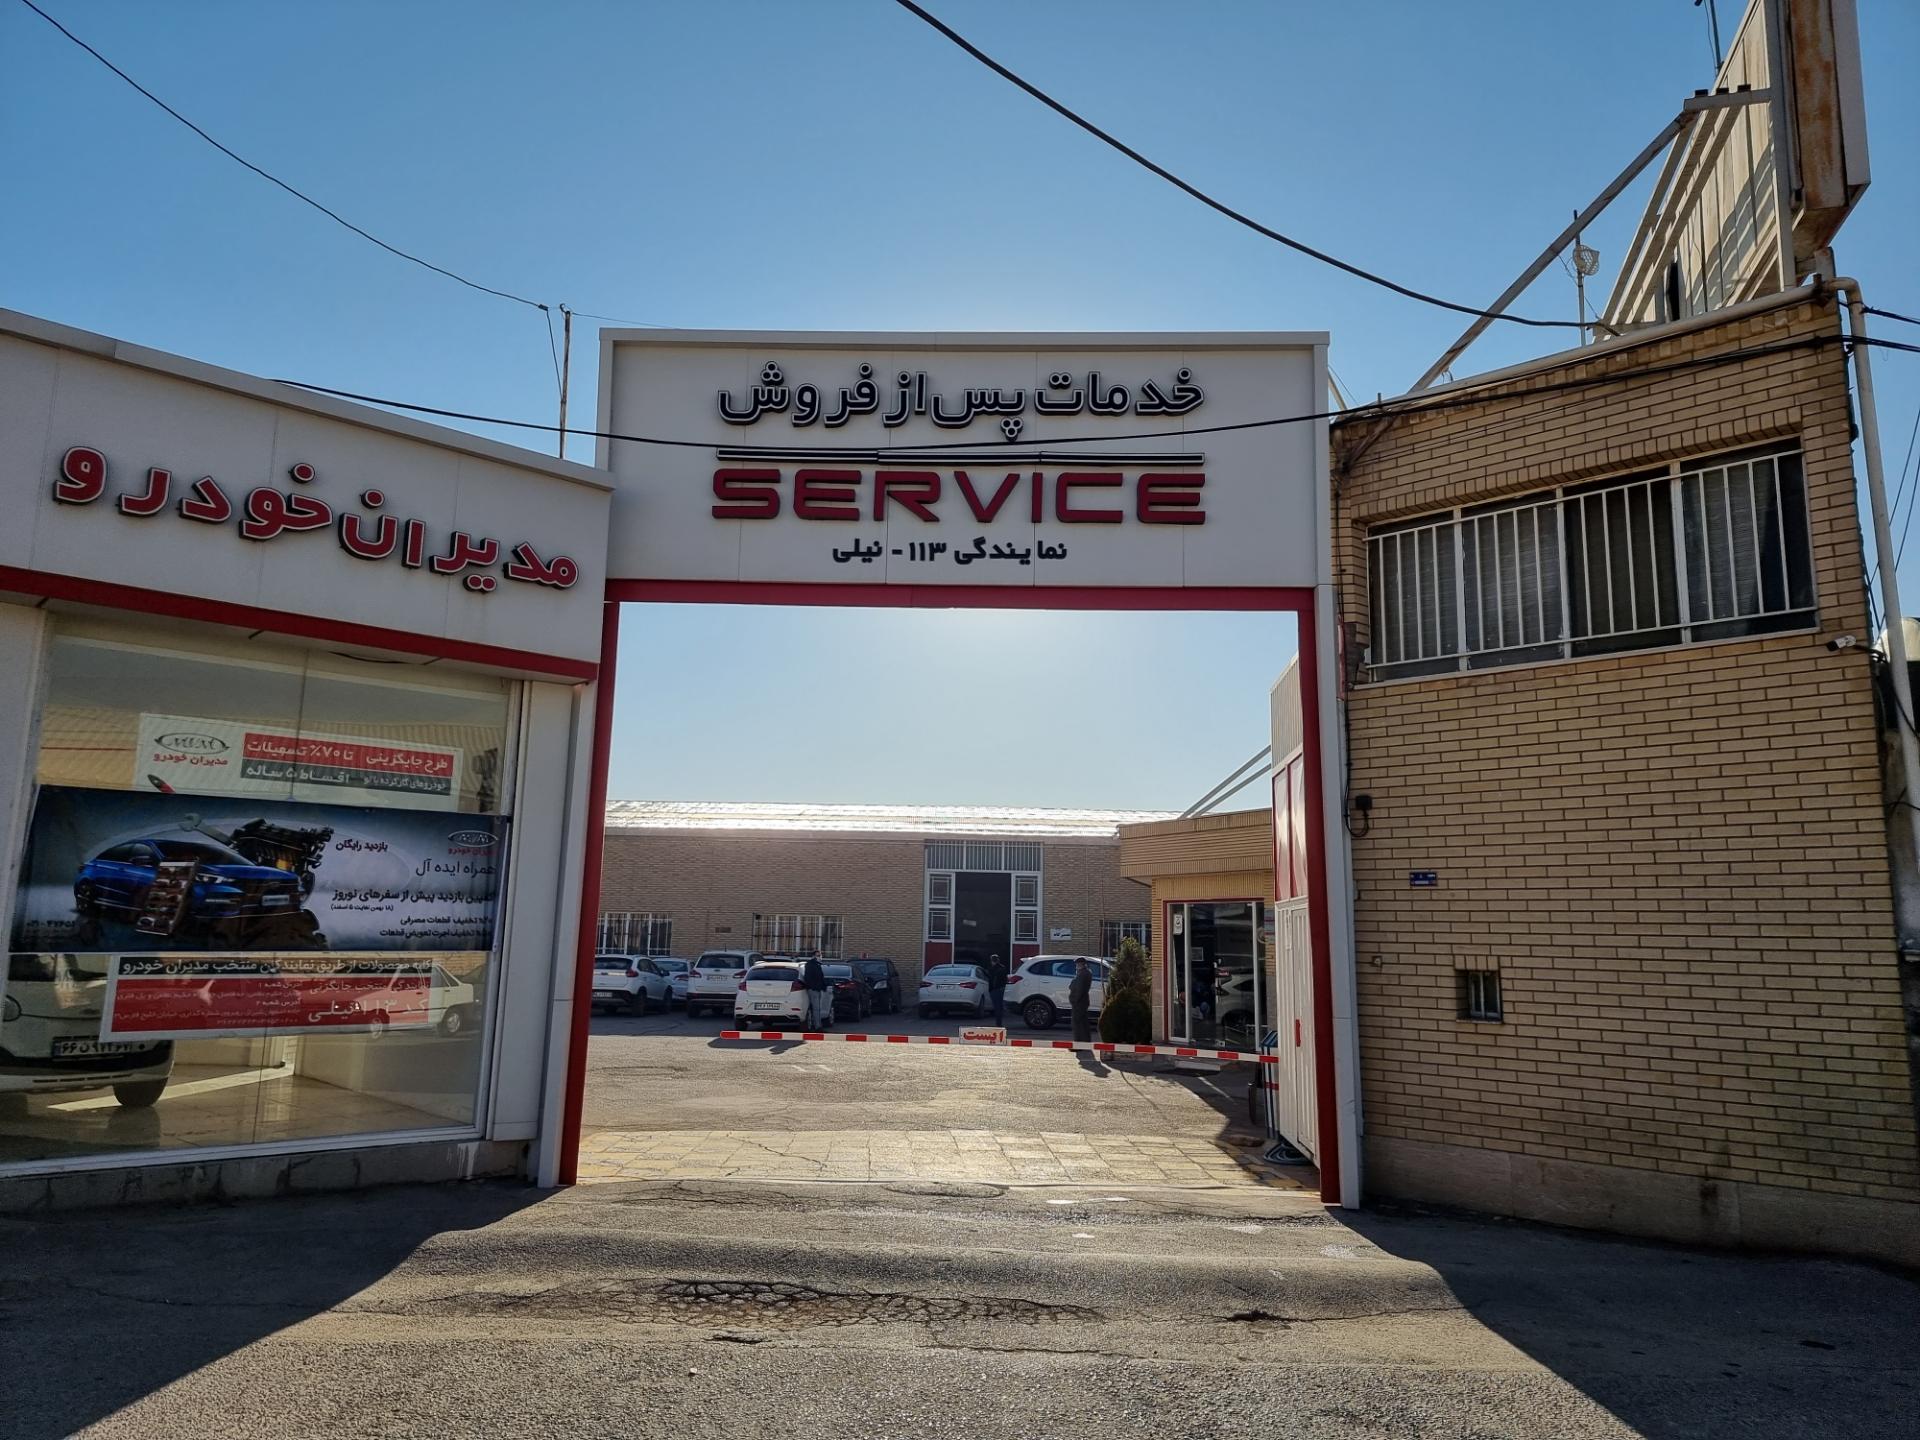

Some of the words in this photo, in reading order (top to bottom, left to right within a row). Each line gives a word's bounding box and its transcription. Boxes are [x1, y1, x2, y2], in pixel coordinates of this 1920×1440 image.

[717, 360, 880, 427] فروش
[1035, 368, 1204, 415] خدمات
[882, 372, 928, 428] از
[930, 384, 1024, 442] پس
[53, 445, 334, 541] خودرو
[711, 468, 1206, 524] SERVICE
[335, 489, 580, 593] مدیران
[831, 537, 883, 564] نیلی
[908, 542, 948, 561] ۱۱۳
[953, 536, 1068, 566] نمایندگی
[152, 751, 188, 764] خودرو
[246, 741, 307, 759] تسهیلات
[342, 748, 355, 760] تا
[189, 755, 229, 767] مدیران
[366, 751, 423, 770] جایگزینی
[423, 756, 449, 774] طرح
[246, 766, 282, 778] ساله
[302, 770, 351, 785] اقساط
[335, 838, 362, 852] رایگان
[364, 840, 388, 852] بازدید
[415, 858, 432, 877] آل
[434, 861, 460, 877] ایده
[331, 889, 358, 902] نوروز
[359, 889, 400, 902] سفرهای
[401, 888, 411, 903] از
[410, 890, 435, 904] پیش
[437, 890, 465, 904] بازدید
[123, 960, 164, 974] خودرو
[165, 959, 209, 974] مدیران
[212, 960, 257, 972] منتخب
[316, 959, 346, 974] طریق
[963, 1030, 1004, 1044] ایست
